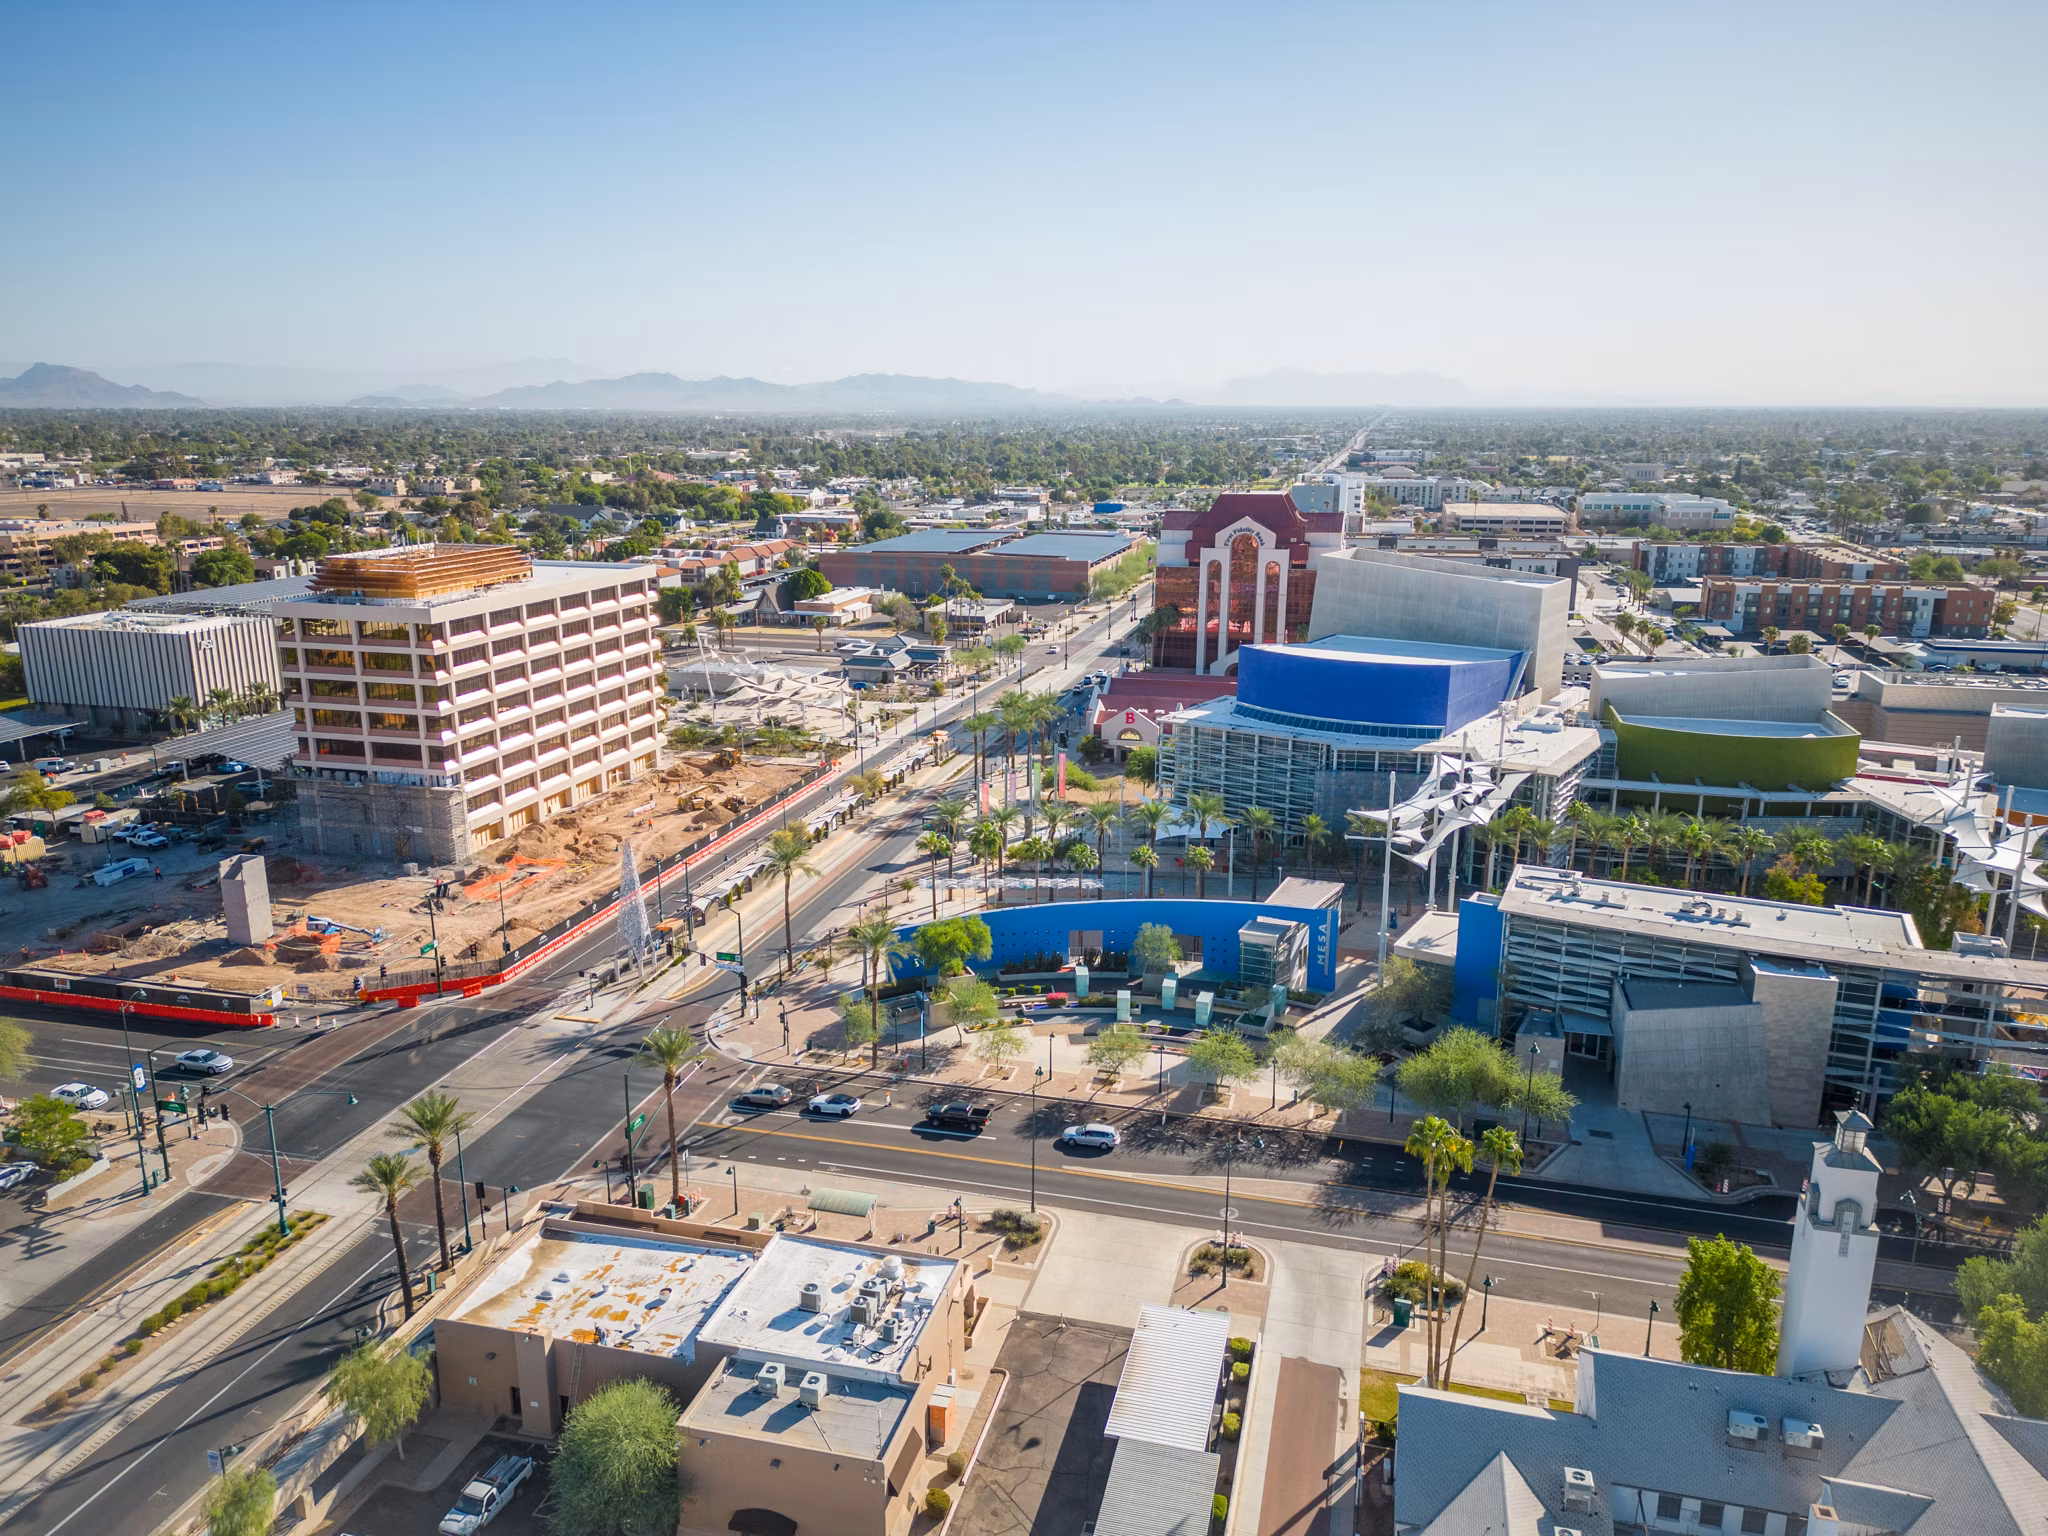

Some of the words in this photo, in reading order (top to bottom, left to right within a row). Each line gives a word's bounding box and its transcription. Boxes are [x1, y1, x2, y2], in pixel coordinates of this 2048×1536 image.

[1224, 533, 1233, 546] First
[1233, 527, 1254, 535] Fidelity
[1255, 531, 1265, 546] Bank
[1125, 711, 1135, 724] B
[1317, 924, 1327, 965] MESA
